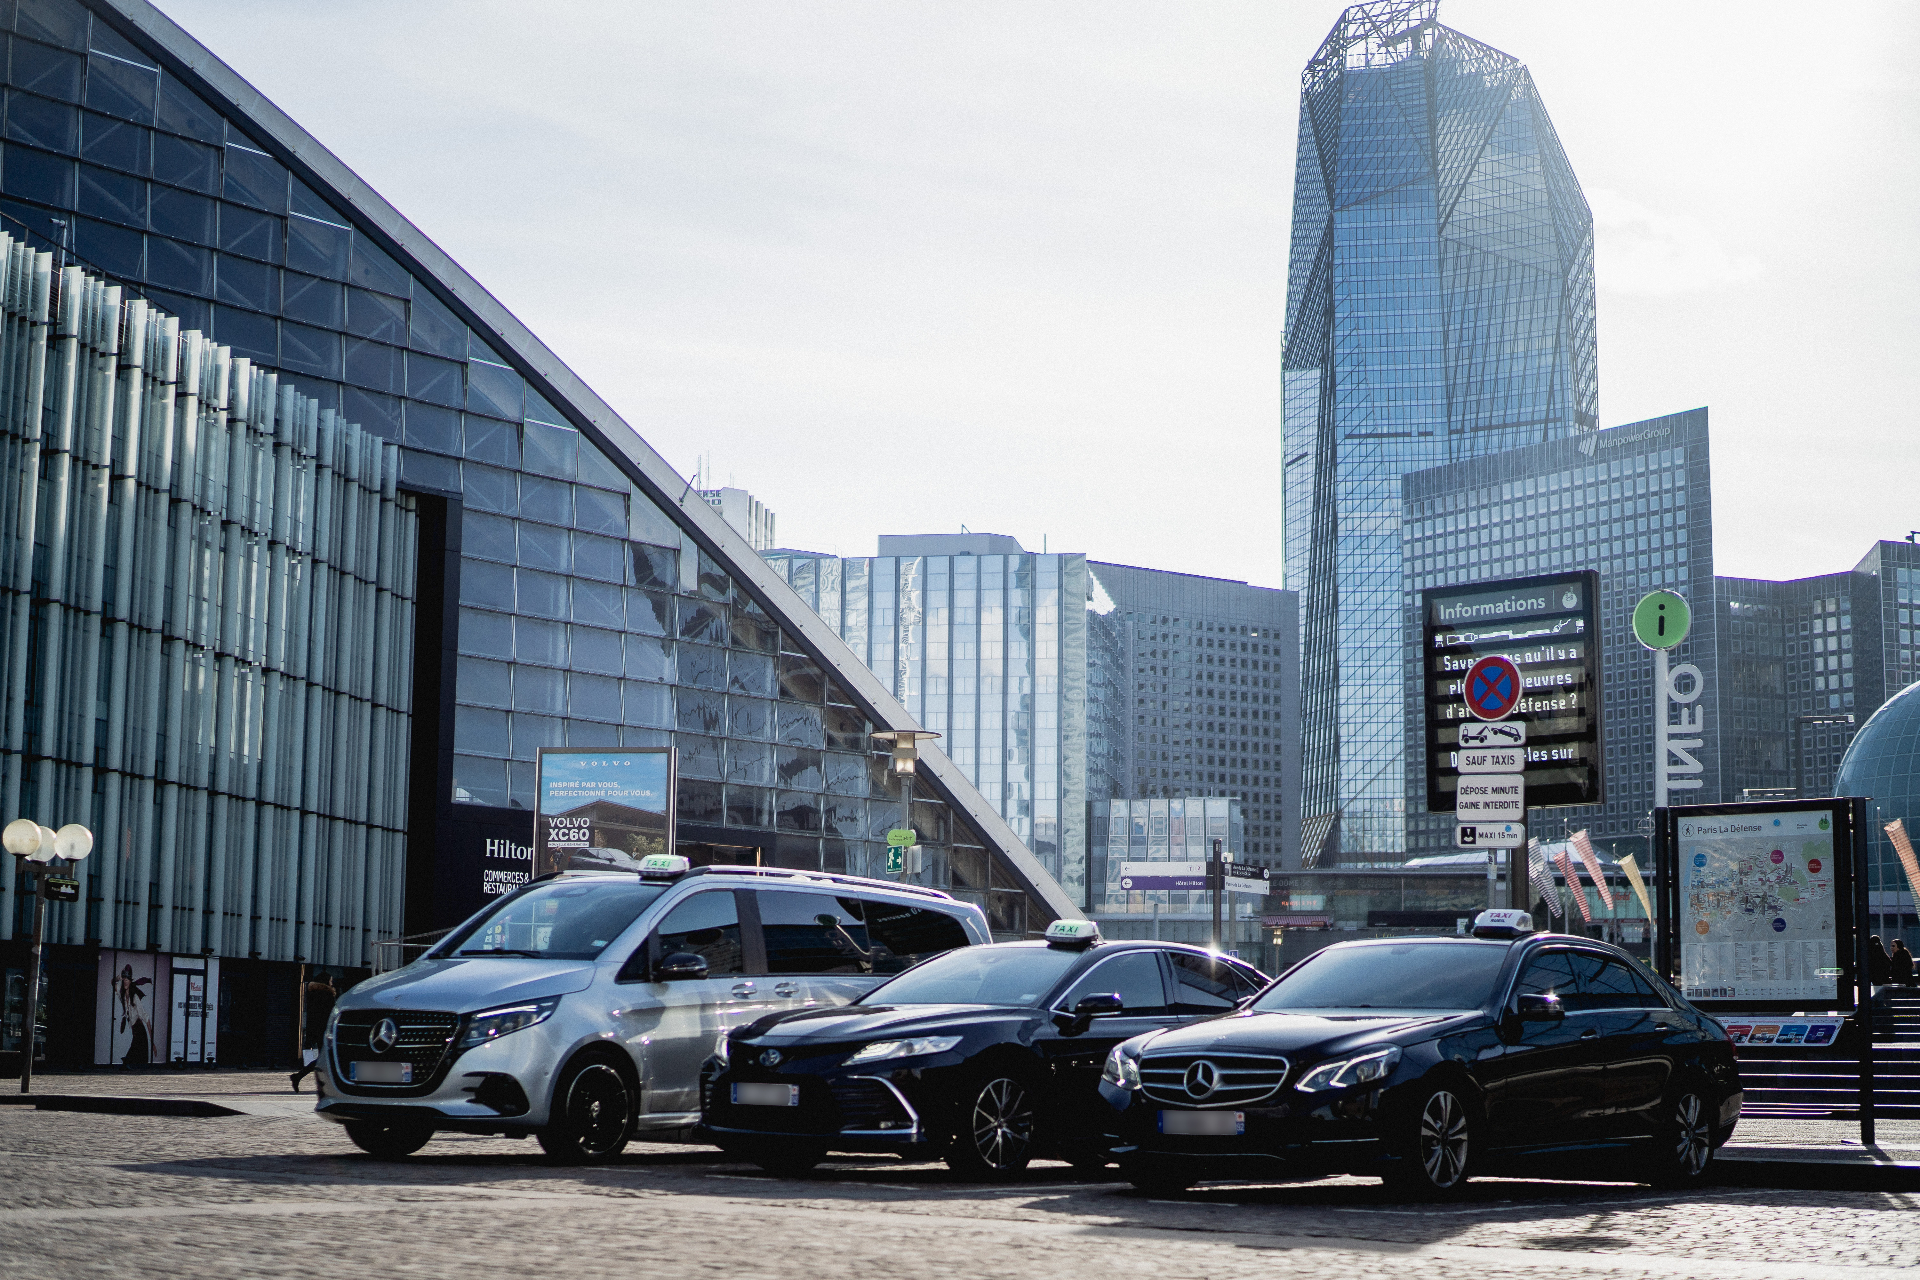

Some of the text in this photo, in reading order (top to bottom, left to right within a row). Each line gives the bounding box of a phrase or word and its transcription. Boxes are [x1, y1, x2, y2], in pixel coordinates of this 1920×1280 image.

[1600, 427, 1671, 449] ManpowerGroup
[1440, 595, 1546, 620] Informations
[1558, 650, 1566, 660] y
[1569, 648, 1577, 659] a
[1551, 748, 1574, 760] sur
[1465, 755, 1488, 766] SAUF
[1490, 754, 1516, 765] TAXIS
[549, 780, 580, 788] INSPIRÉ
[597, 781, 621, 789] VOUS,
[1460, 784, 1519, 795] DÉPOSE MINUTE
[549, 789, 606, 797] PERFECTIONNÉ
[1458, 801, 1520, 810] GAINE INTERDITE
[548, 817, 590, 828] VOLVO
[1697, 823, 1762, 834] Paris La Défense
[548, 828, 590, 841] XC60
[646, 859, 672, 867] TAXI
[483, 869, 530, 884] COMMERCES &
